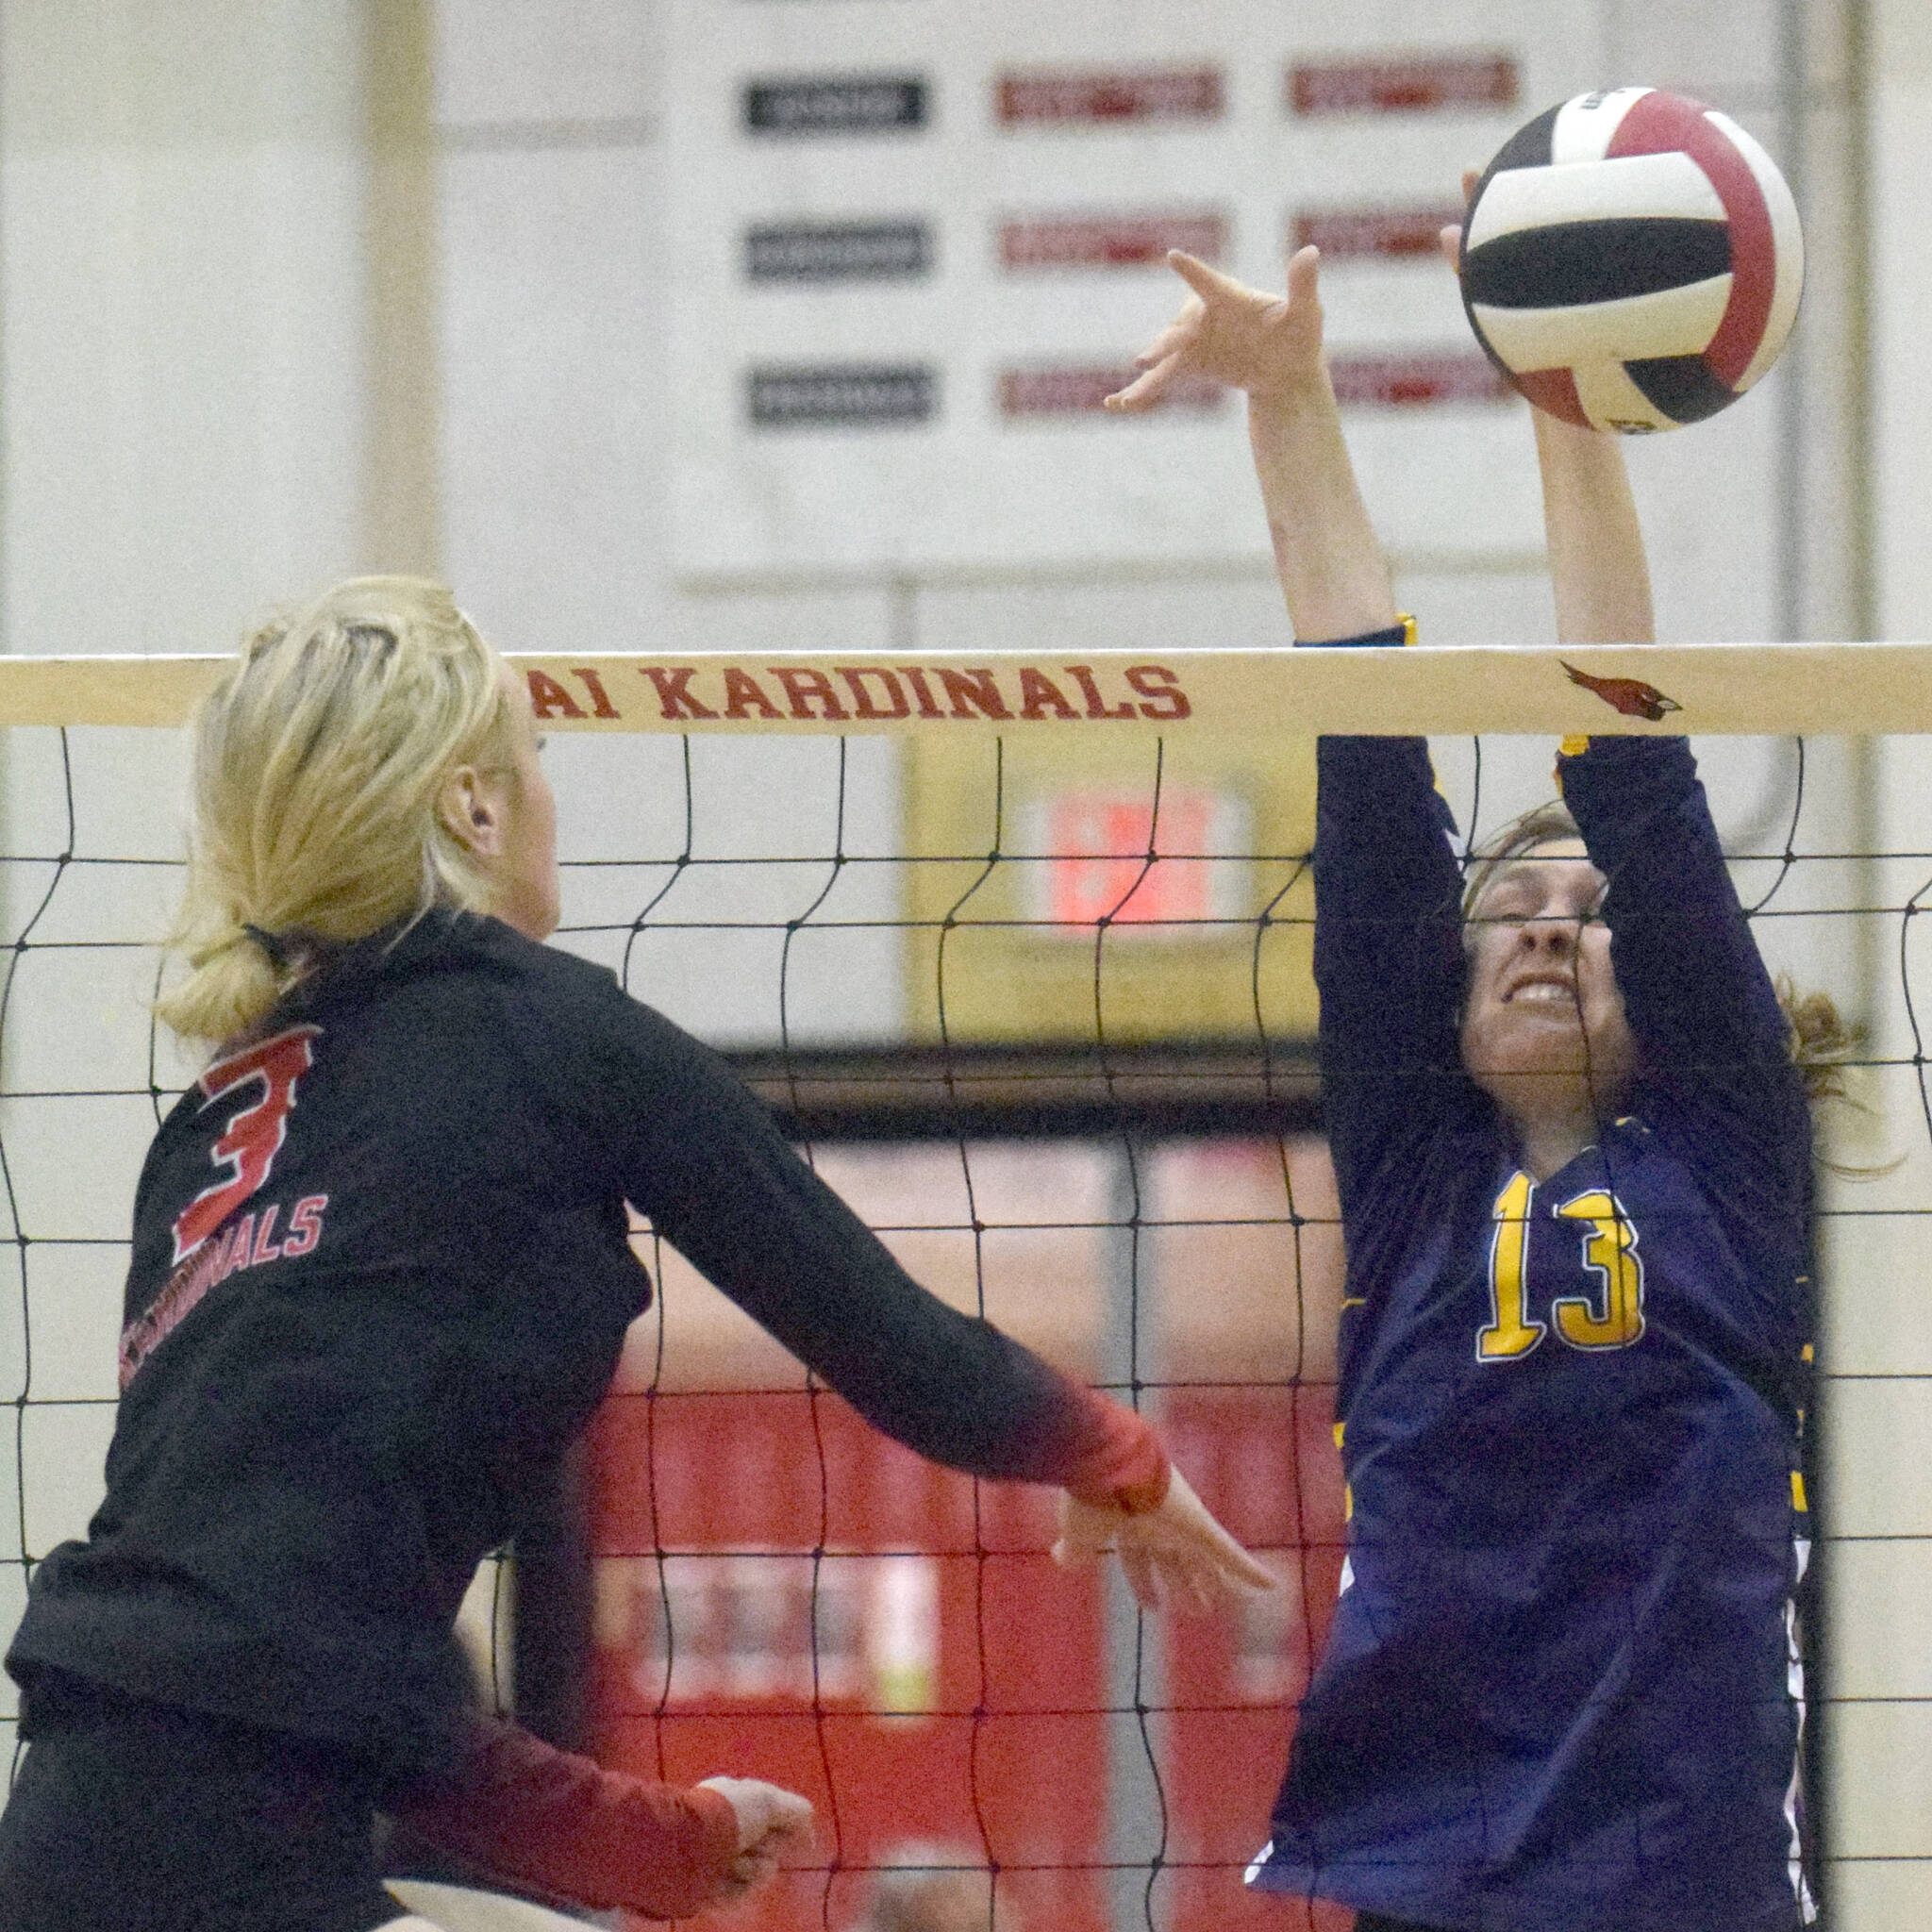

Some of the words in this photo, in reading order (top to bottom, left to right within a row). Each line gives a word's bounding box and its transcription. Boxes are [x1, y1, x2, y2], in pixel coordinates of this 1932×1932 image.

[640, 665, 1192, 722] KARDINALS
[172, 1024, 325, 1267] 3
[1476, 1170, 1645, 1363] 13
